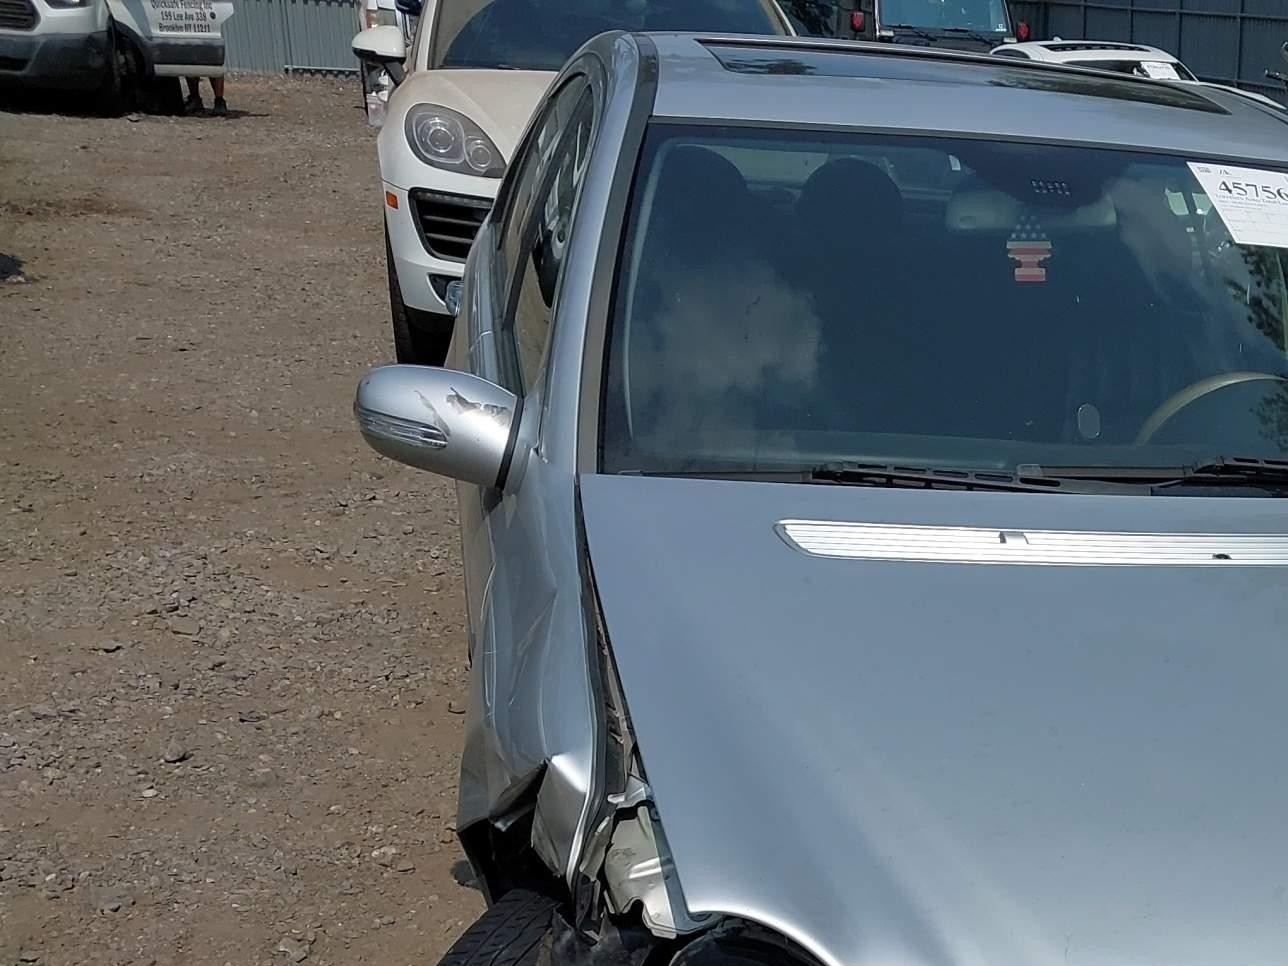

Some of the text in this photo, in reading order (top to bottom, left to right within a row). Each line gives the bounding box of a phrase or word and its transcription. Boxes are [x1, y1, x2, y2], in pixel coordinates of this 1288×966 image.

[159, 23, 211, 32] Brooklyn NY 11211
